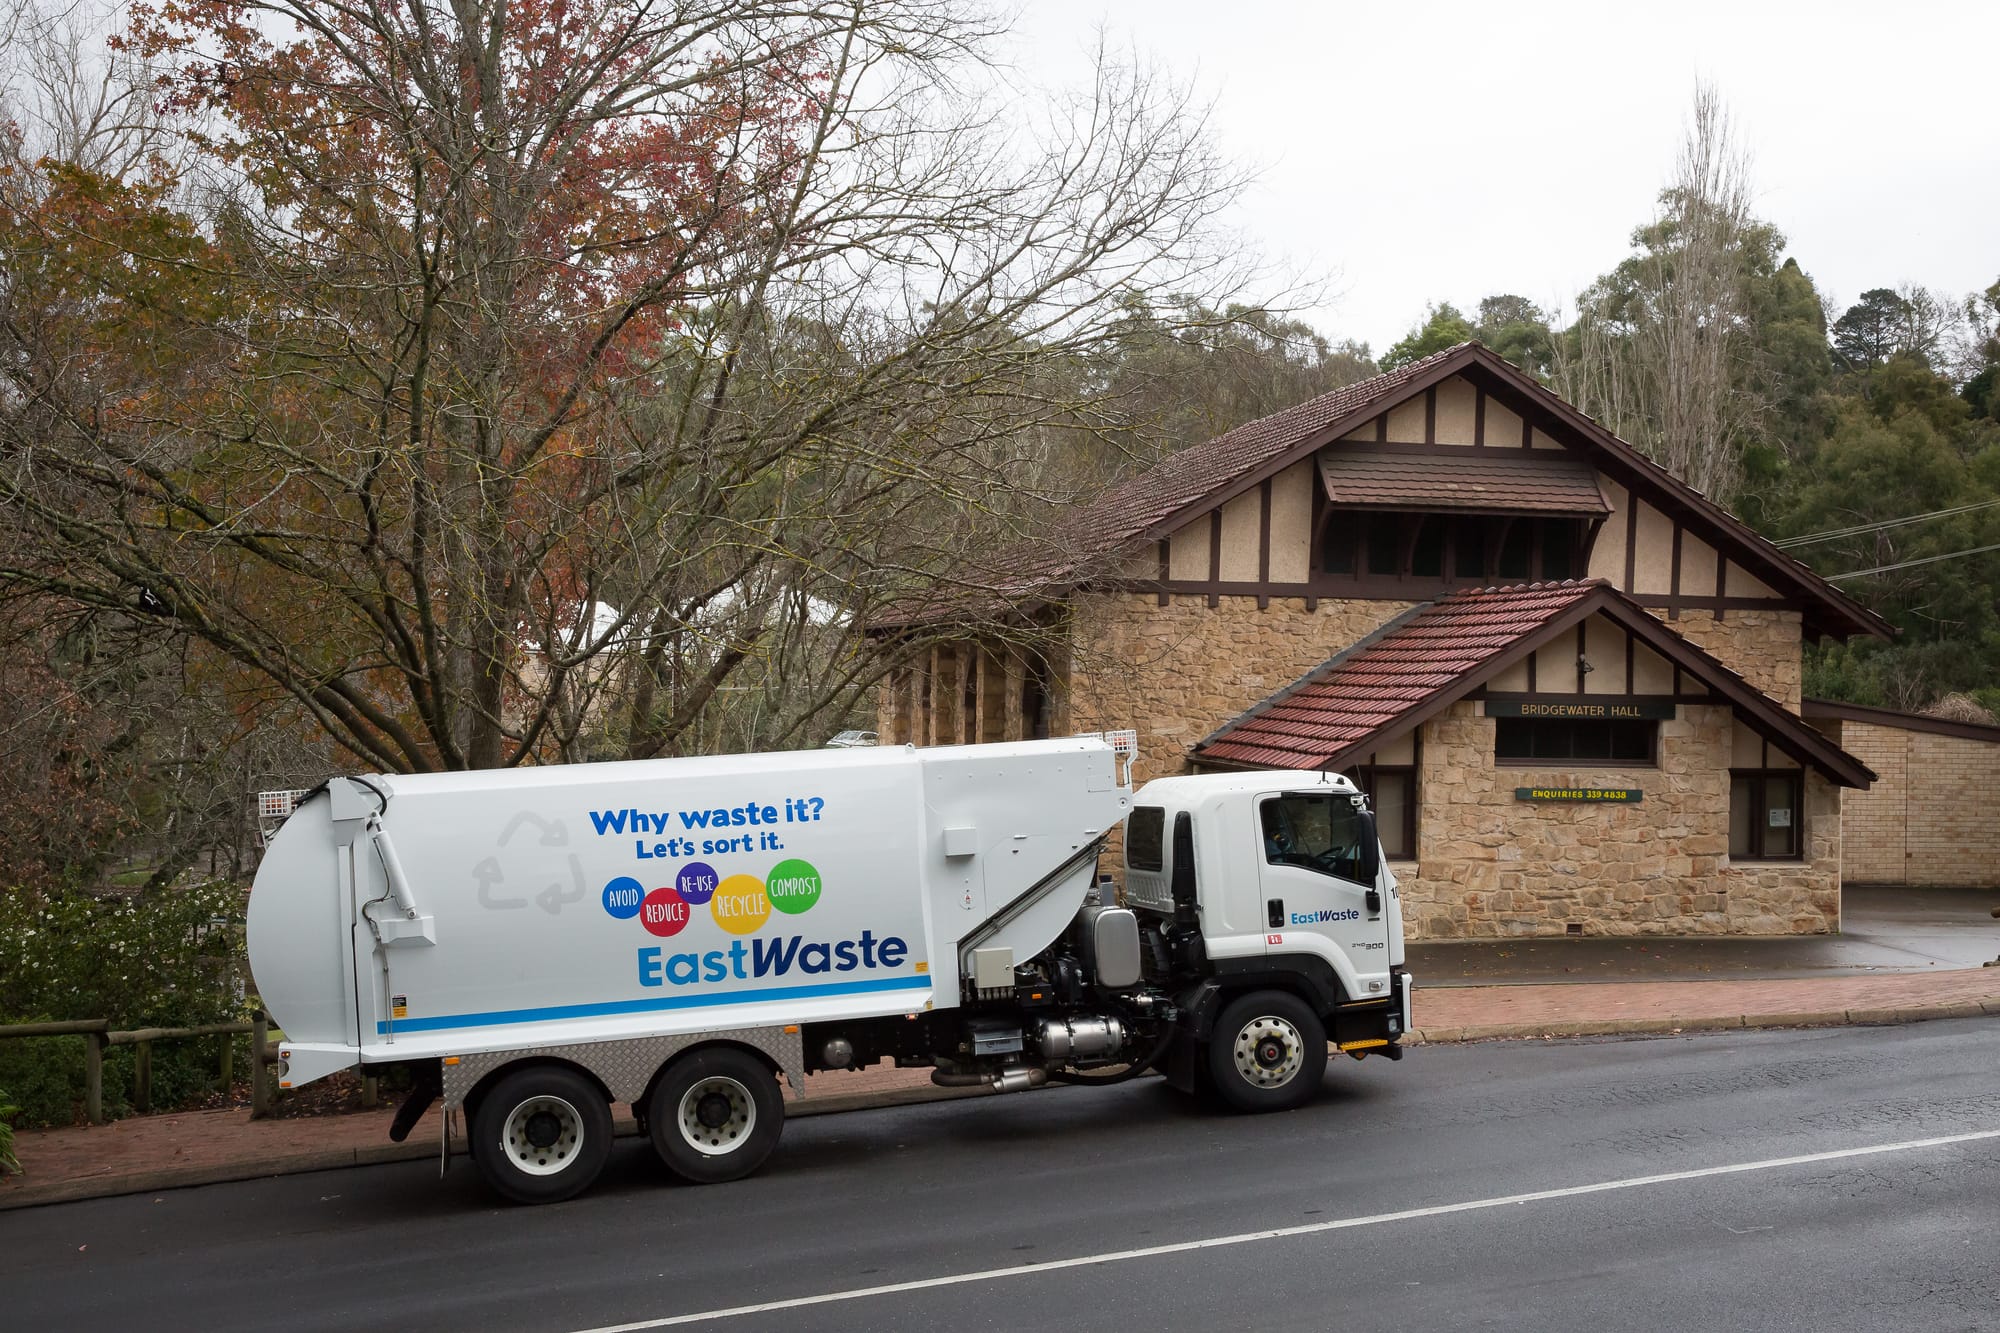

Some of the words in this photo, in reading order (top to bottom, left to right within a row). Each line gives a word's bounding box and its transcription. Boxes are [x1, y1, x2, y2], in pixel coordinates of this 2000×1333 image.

[1521, 704, 1605, 717] BRIDGEWATER
[1611, 706, 1641, 718] HALL
[1532, 790, 1583, 799] ENQUIRIES
[1586, 790, 1602, 800] 339
[589, 808, 670, 836] Why
[679, 802, 778, 830] waste
[785, 797, 825, 823] it?
[635, 836, 696, 860] Let's
[702, 834, 753, 855] sort
[760, 831, 785, 851] it.
[681, 875, 714, 893] RE-USE
[770, 877, 817, 897] COMPOST
[608, 888, 639, 908] AVOID
[716, 893, 766, 918] RECYCLE
[645, 902, 685, 923] REDUCE
[1291, 909, 1360, 924] EastWaste
[637, 930, 909, 987] EastWaste
